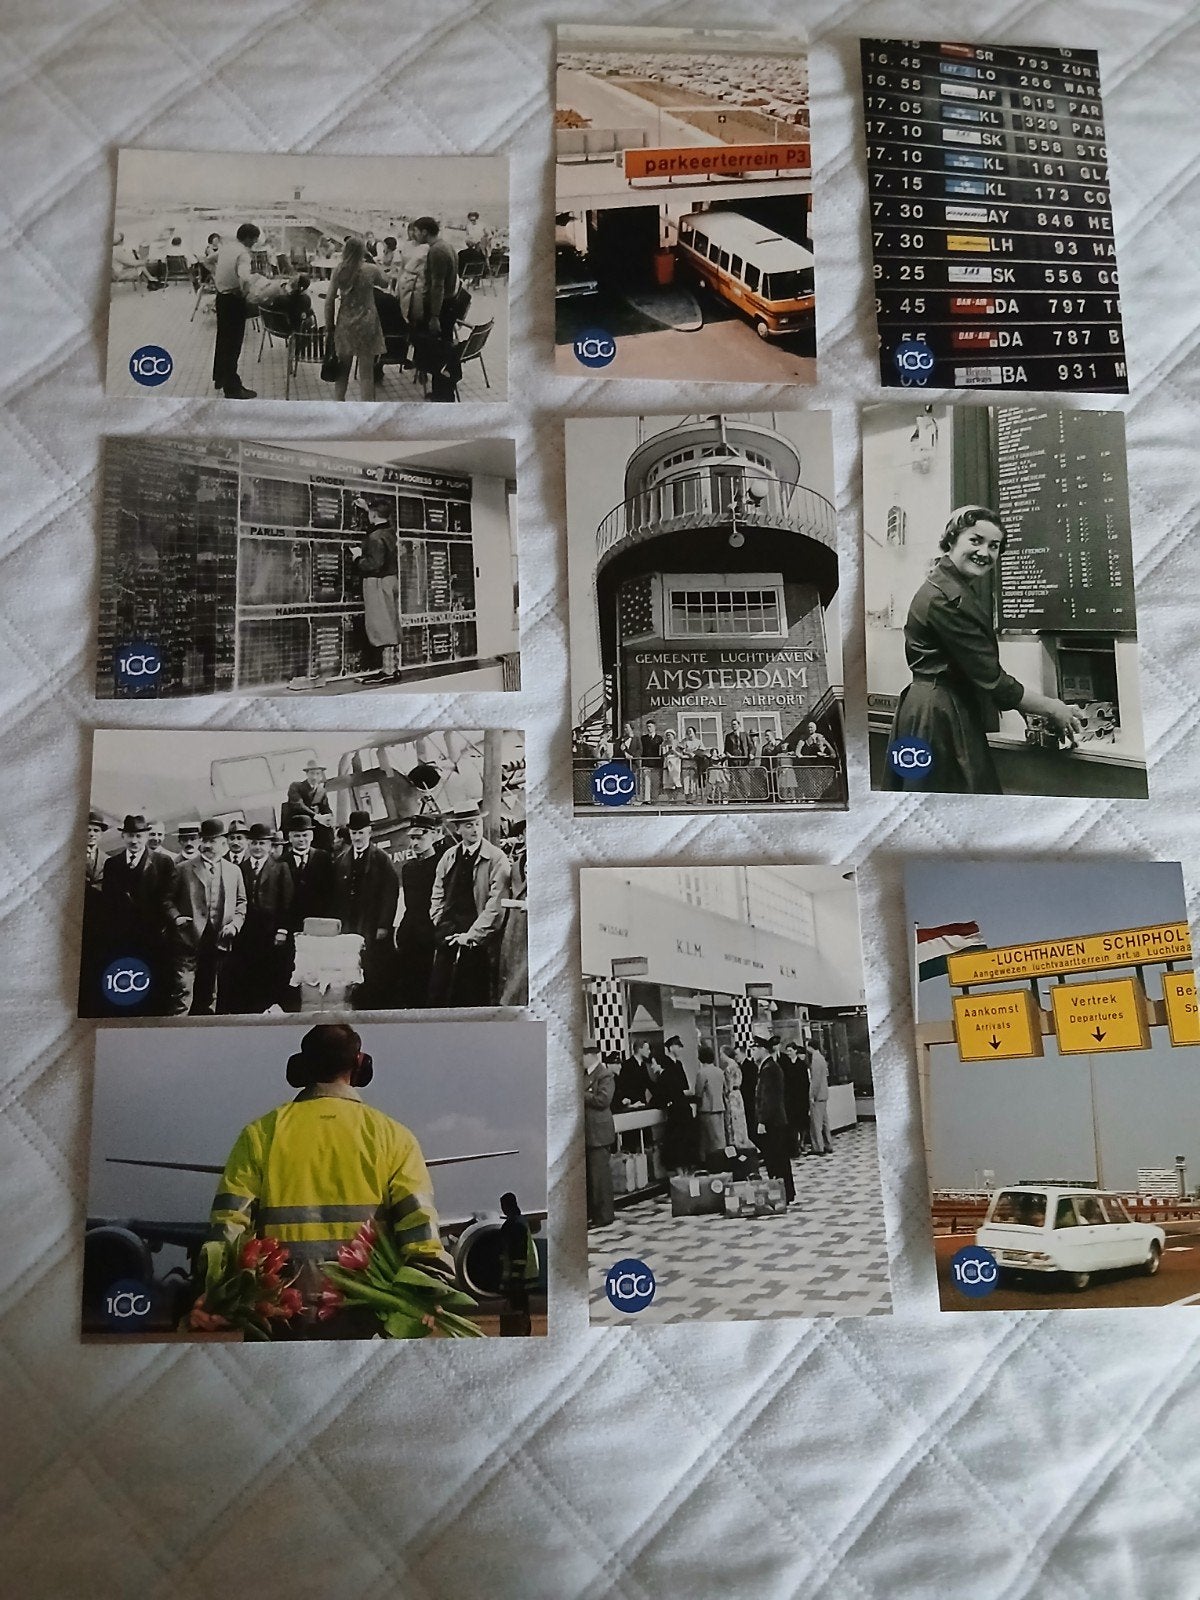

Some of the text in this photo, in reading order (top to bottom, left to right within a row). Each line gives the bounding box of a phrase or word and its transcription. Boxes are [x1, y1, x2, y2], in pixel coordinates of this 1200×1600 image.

[976, 49, 993, 61] SR
[1018, 56, 1048, 70] 793
[977, 69, 996, 80] LO
[1020, 76, 1052, 89] 266
[979, 89, 996, 100] AF
[980, 111, 999, 123] KL
[1025, 116, 1058, 130] 329
[982, 133, 1002, 146] SK
[1028, 139, 1061, 153] 558
[645, 149, 806, 174] parkeerterrein P3
[984, 157, 1004, 170] KL
[1032, 162, 1064, 176] 161
[986, 182, 1006, 196] KL
[1035, 187, 1069, 201] 173
[1084, 190, 1110, 204] CO
[988, 209, 1009, 223] AY
[1037, 212, 1074, 228] 846
[991, 237, 1013, 252] LH
[1054, 240, 1078, 255] 93
[993, 267, 1016, 283] SK
[1044, 269, 1082, 284] 556
[995, 298, 1019, 314] DA
[1048, 299, 1086, 314] 797
[998, 331, 1023, 347] DA
[1053, 330, 1091, 346] 787
[1108, 329, 1120, 345] B
[1002, 365, 1028, 383] BA
[1058, 363, 1096, 380] 931
[635, 651, 815, 664] GEMEENTE LUCHTHAVEN
[646, 667, 808, 690] AMSTERDAM
[650, 694, 805, 707] MUNICIPAL AIRPORT
[973, 965, 1027, 978] Aangewezen
[1071, 994, 1117, 1007] Vertrek
[964, 1004, 1019, 1017] Aankomst
[1069, 1012, 1124, 1024] Departures
[975, 1021, 1011, 1031] Arrivals
